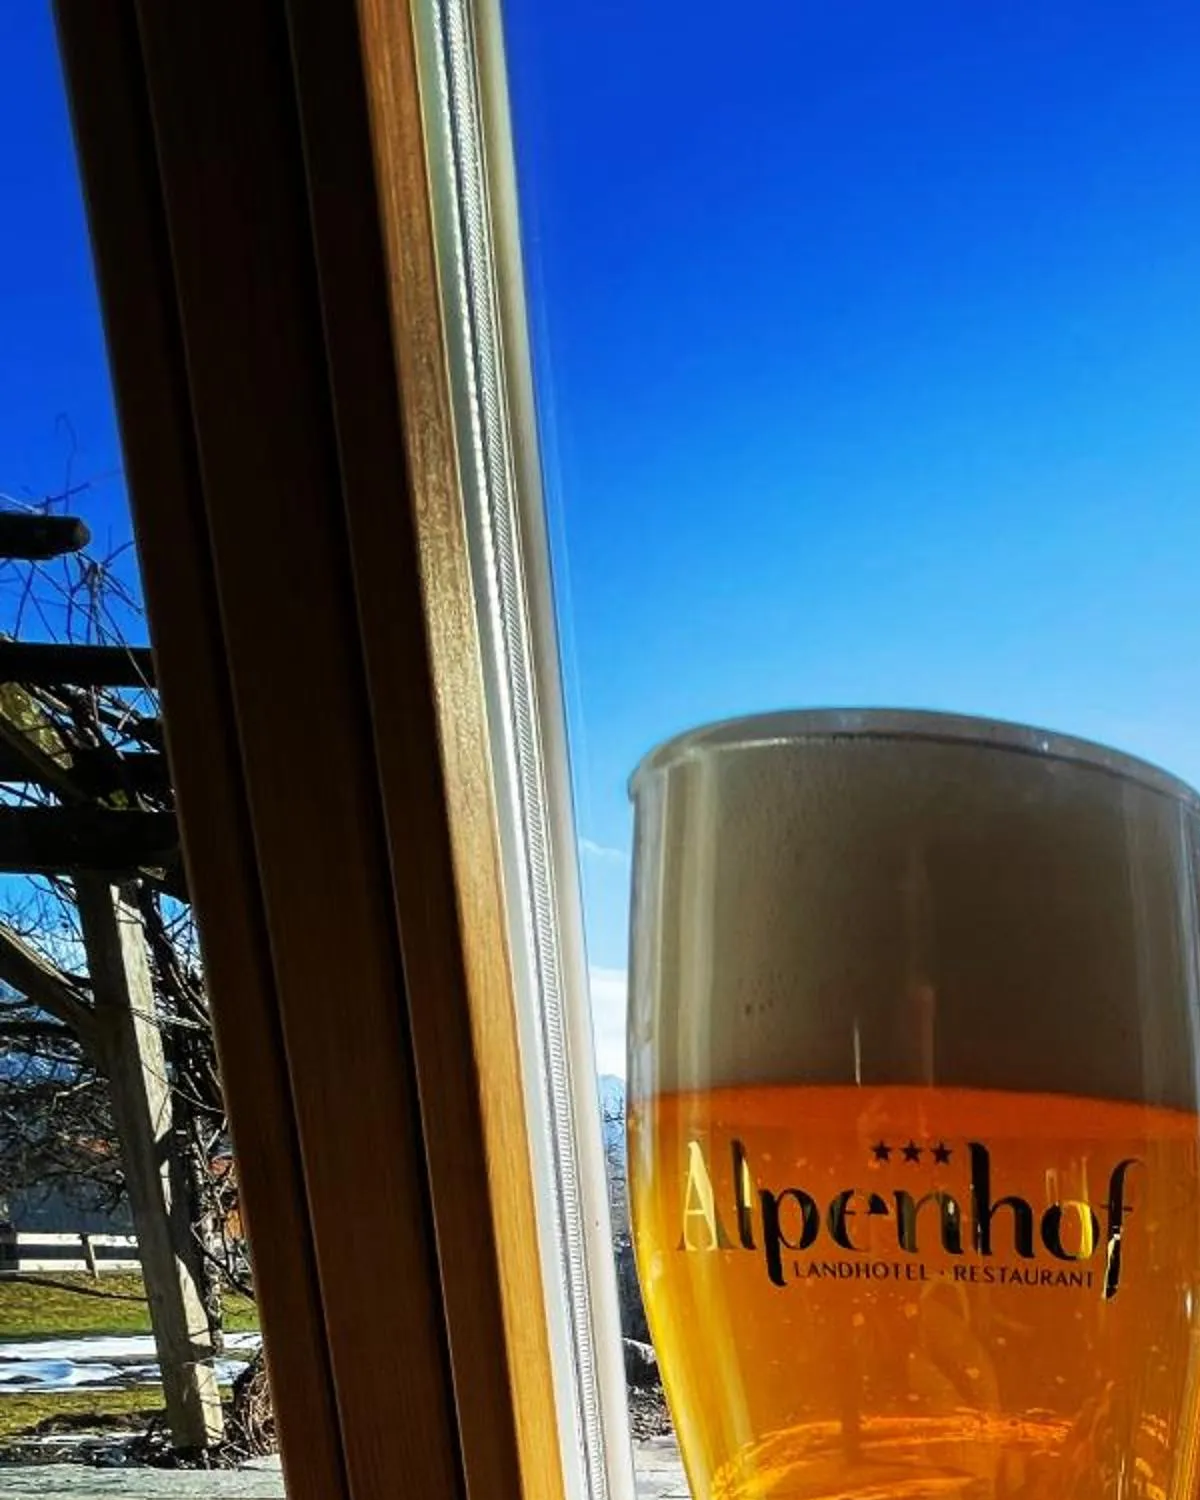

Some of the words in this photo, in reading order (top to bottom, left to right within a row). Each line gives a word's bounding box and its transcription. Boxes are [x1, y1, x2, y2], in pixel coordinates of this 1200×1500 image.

[677, 1139, 1147, 1299] Alpenhof
[792, 1260, 927, 1282] LANDHOTEL
[953, 1264, 1094, 1289] RESTAURANT
